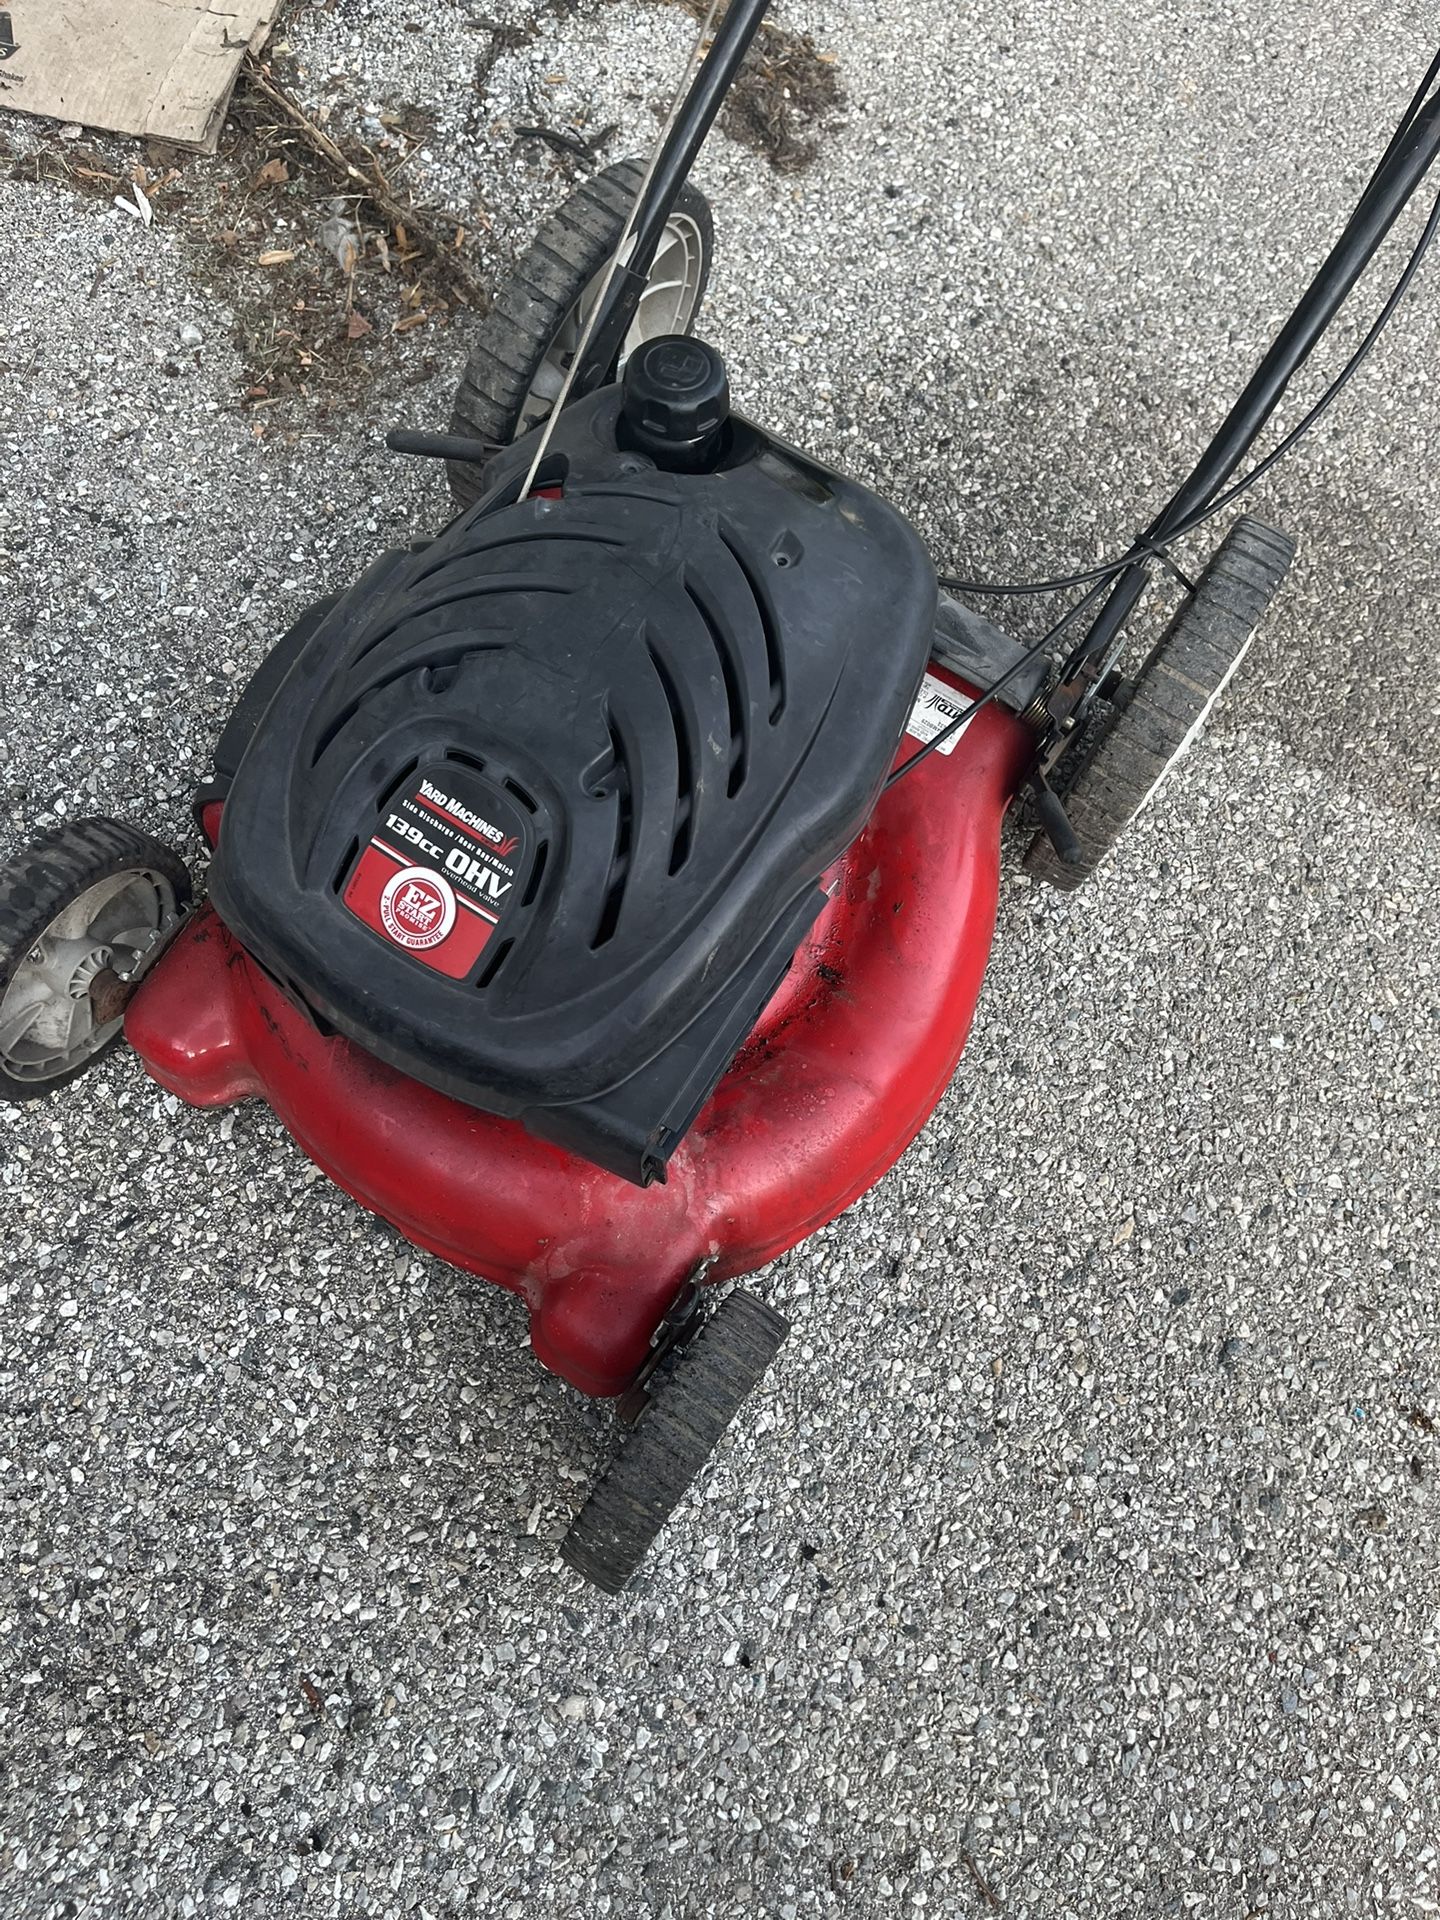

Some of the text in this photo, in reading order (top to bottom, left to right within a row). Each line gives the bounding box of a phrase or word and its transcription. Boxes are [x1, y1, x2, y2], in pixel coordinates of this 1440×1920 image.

[402, 799, 418, 814] Side
[418, 810, 454, 838] Discharge
[419, 779, 504, 843] YARD MACHINES
[385, 813, 513, 899] 139cc OHV
[402, 883, 442, 920] EZ
[441, 867, 500, 907] overhead valve
[397, 900, 432, 926] START
[388, 922, 406, 941] START
[406, 930, 444, 946] GUARANTEE
